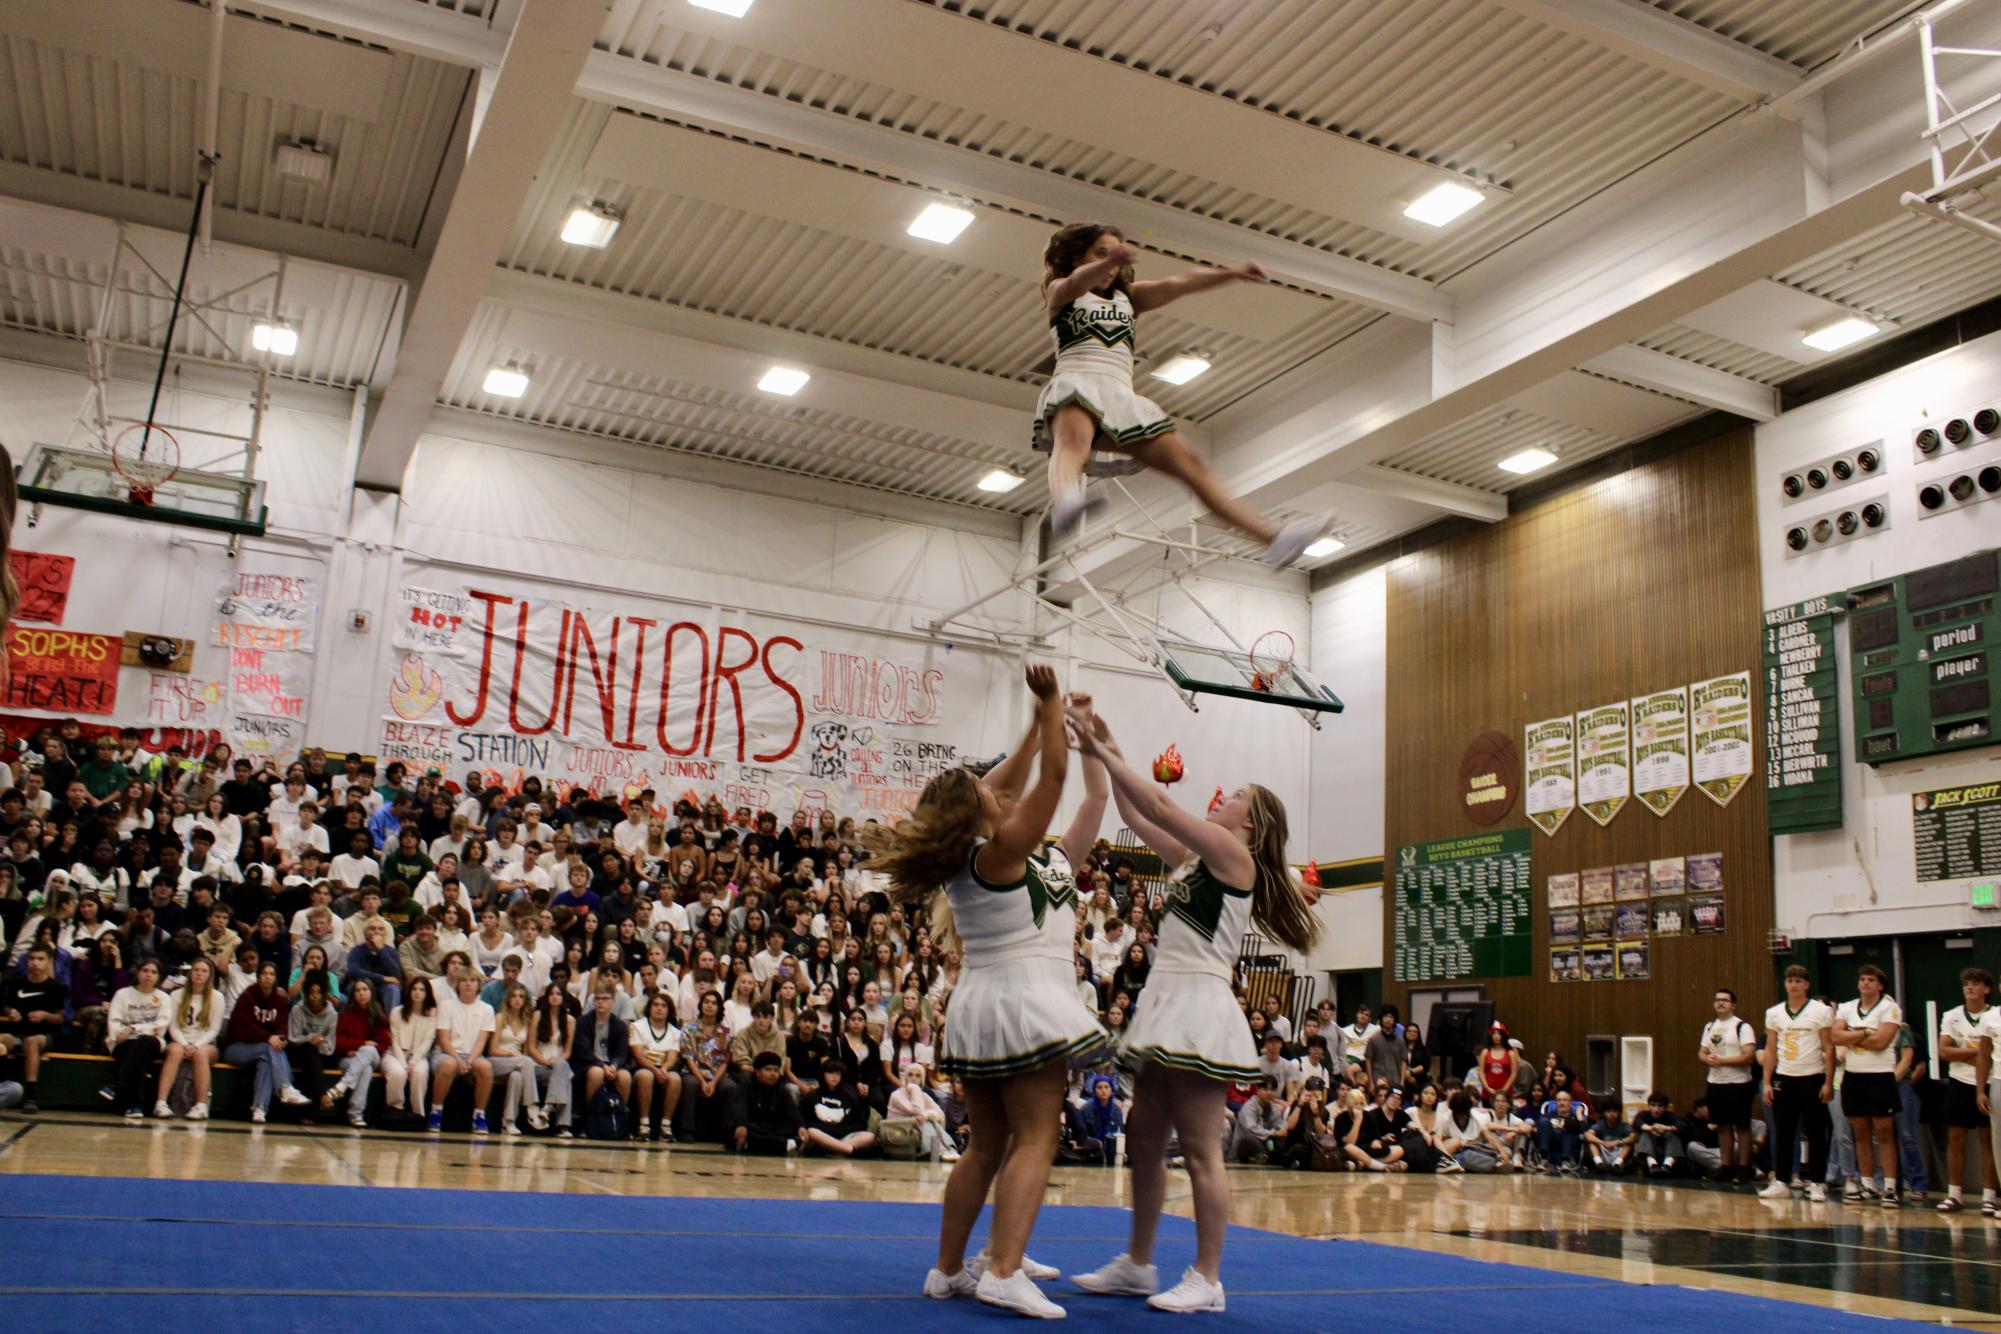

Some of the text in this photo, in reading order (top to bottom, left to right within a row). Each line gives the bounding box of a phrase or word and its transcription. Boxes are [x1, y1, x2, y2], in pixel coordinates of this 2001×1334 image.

[410, 607, 462, 633] HOT
[12, 629, 109, 661] SOPHS
[1933, 624, 1976, 652] period
[444, 589, 805, 764] JUNIORS
[1936, 657, 1980, 681] player
[7, 671, 106, 711] HEAT!
[150, 672, 204, 698] FIRE
[270, 696, 305, 717] OUT
[384, 721, 452, 749] BLAZE
[381, 743, 453, 764] THROUGH
[457, 732, 550, 771] STATION
[918, 742, 957, 761] BRING
[659, 760, 717, 781] JUNIORS
[739, 766, 774, 786] GET
[892, 759, 912, 772] ON
[1767, 761, 1781, 774] 15
[1767, 774, 1780, 788] 16
[725, 784, 772, 808] FIRED
